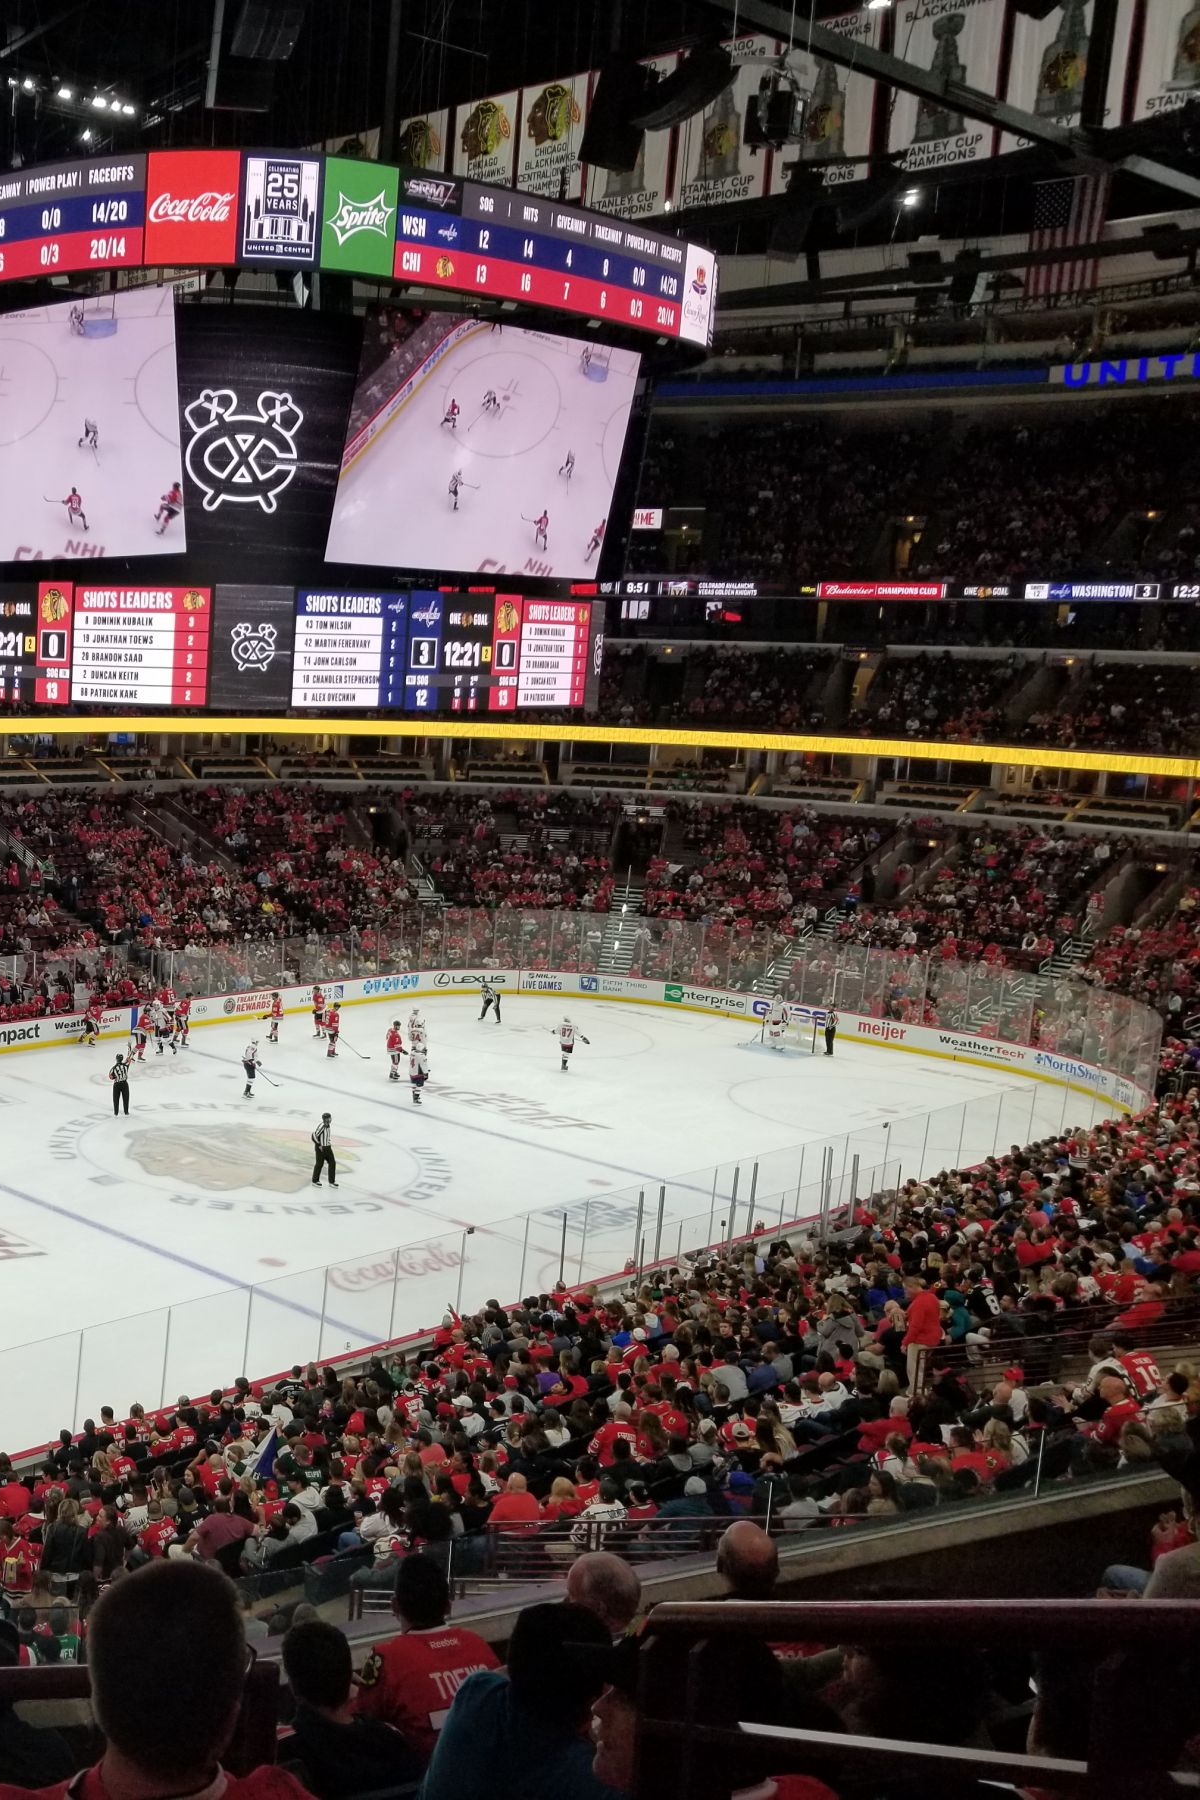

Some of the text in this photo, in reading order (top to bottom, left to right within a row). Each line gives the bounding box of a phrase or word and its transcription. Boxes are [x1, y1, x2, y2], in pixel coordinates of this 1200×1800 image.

[955, 134, 983, 148] CUP
[535, 143, 567, 157] CHICAGO
[525, 152, 575, 170] BLACKHAWKS
[900, 149, 976, 169] CHAMPIONS
[268, 165, 299, 174] CELEBRATING
[29, 174, 56, 194] POWER
[56, 171, 78, 189] PLAY
[88, 165, 134, 185] FACEOFFS
[519, 171, 550, 183] CENTRAL
[267, 173, 299, 199] 25
[681, 175, 754, 195] STANLEY CUP
[637, 191, 658, 204] CUP
[684, 186, 749, 204] CHAMPIONS
[148, 192, 236, 225] Coca-Cola
[266, 198, 298, 211] YEARS
[41, 207, 61, 230] 0/0
[92, 200, 128, 224] 14/20
[336, 205, 385, 230] Sprite
[479, 196, 682, 264] SOG HITS GIVEAWAY TAKEAWAY POWER PLAY FACEOFFS
[40, 242, 59, 265] 0/3
[90, 236, 126, 260] 20/14
[247, 244, 311, 254] UNITED CENTER
[402, 214, 677, 296] WSH 12 14 0/0 14/20
[402, 251, 675, 327] CHI 13 16 0/3 20/14
[626, 582, 649, 594] 8:51
[825, 584, 874, 595] Budweiser
[878, 587, 919, 595] CHAMPIONS
[920, 587, 937, 595] CLUB
[964, 587, 1009, 596] ONE GOAL
[1072, 585, 1151, 597] WASHINGTON 3
[83, 591, 172, 609] SHOTS LEADERS
[306, 595, 381, 614] SHOTS LEADERS
[16, 603, 31, 615] GOAL
[529, 604, 575, 621] SHOTS LEADERS
[93, 616, 153, 626] DOMINIK KUBALIK
[449, 612, 488, 625] ONE GOAL
[316, 621, 352, 630] TOM WILSON
[83, 634, 153, 644] 19 JONATHAN TOEWS
[314, 639, 371, 648] MARTIN FEHERVARY
[92, 652, 143, 662] BRANDON SAAD
[419, 642, 480, 667] 3 12:21
[313, 657, 357, 666] JOHN CARLSON
[91, 670, 139, 680] DUNCAN KEITH
[312, 675, 379, 684] CHANDLER STEPHENSON
[417, 675, 429, 686] SOG
[46, 682, 57, 699] 13
[90, 688, 138, 699] PATRICK KANE
[311, 693, 356, 702] ALEX OVECHKIN
[416, 689, 508, 706] 12 13
[452, 974, 505, 984] LEXUS
[522, 980, 562, 990] LIVE GAMES
[237, 994, 259, 1003] FREAKY
[667, 985, 745, 1009] enterprise
[236, 1000, 271, 1012] REWARDS
[561, 1027, 573, 1038] 87
[858, 1021, 907, 1041] meijer
[939, 1035, 1025, 1059] WeatherTech
[1043, 1055, 1108, 1085] NorthShore
[48, 1102, 312, 1161] UNITED CENTER
[1075, 1145, 1089, 1158] 19
[170, 1146, 453, 1216] UNITED CENTER
[1135, 1364, 1161, 1391] 19
[430, 1637, 459, 1650] Reebok
